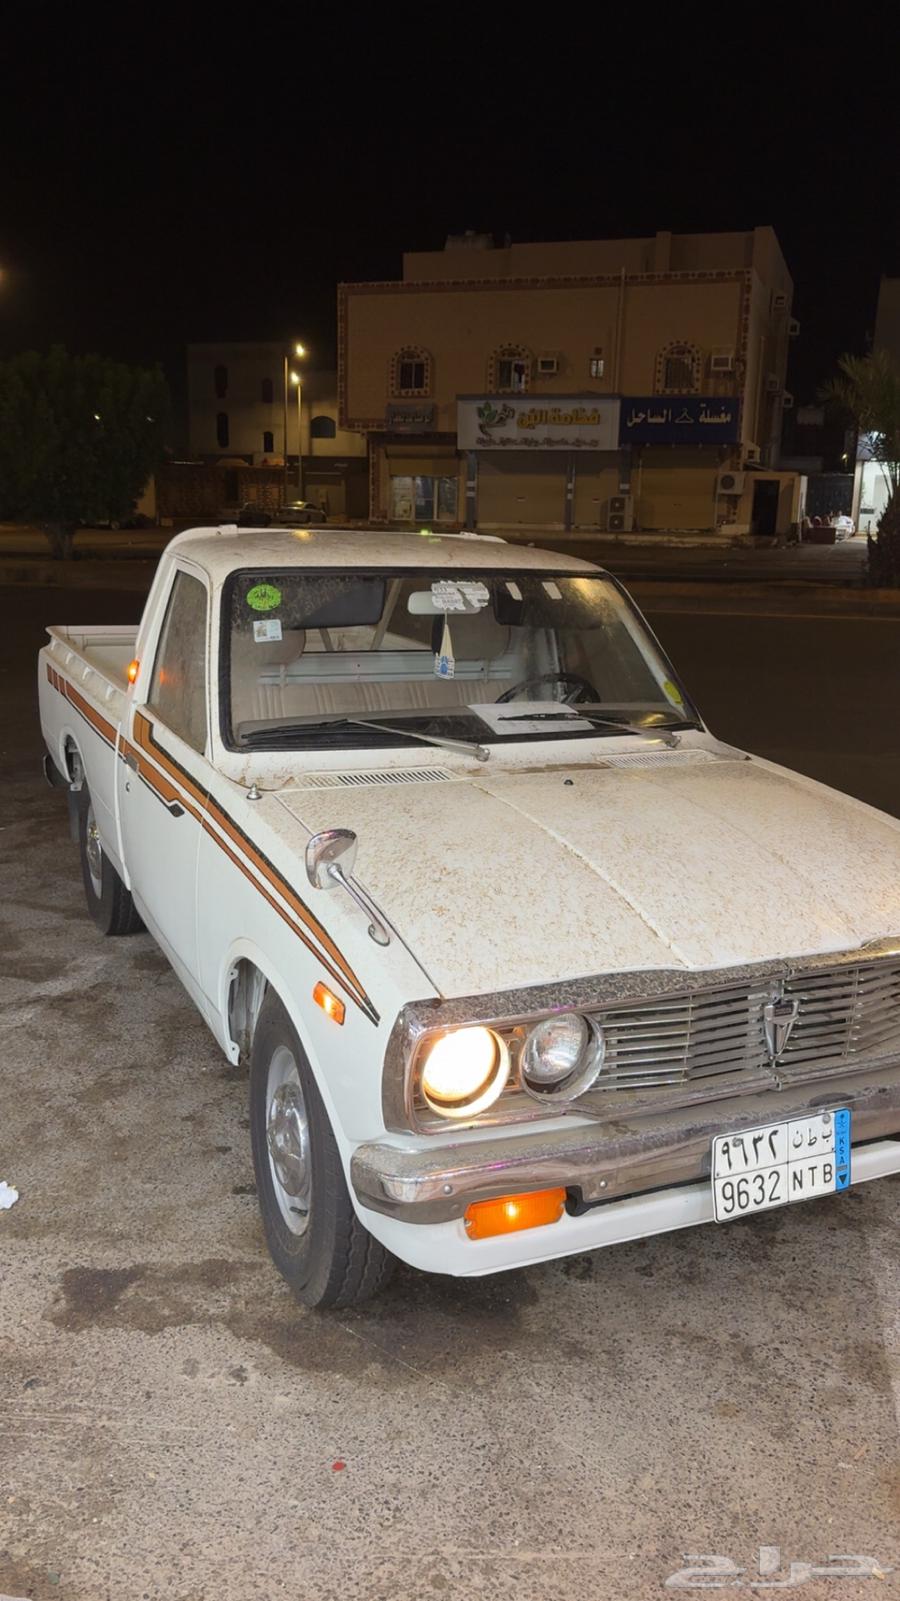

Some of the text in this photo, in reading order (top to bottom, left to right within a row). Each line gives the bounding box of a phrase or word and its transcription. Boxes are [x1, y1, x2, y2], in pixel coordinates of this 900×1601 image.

[626, 403, 733, 428] مغسلة الساحل
[722, 1170, 780, 1214] 9632
